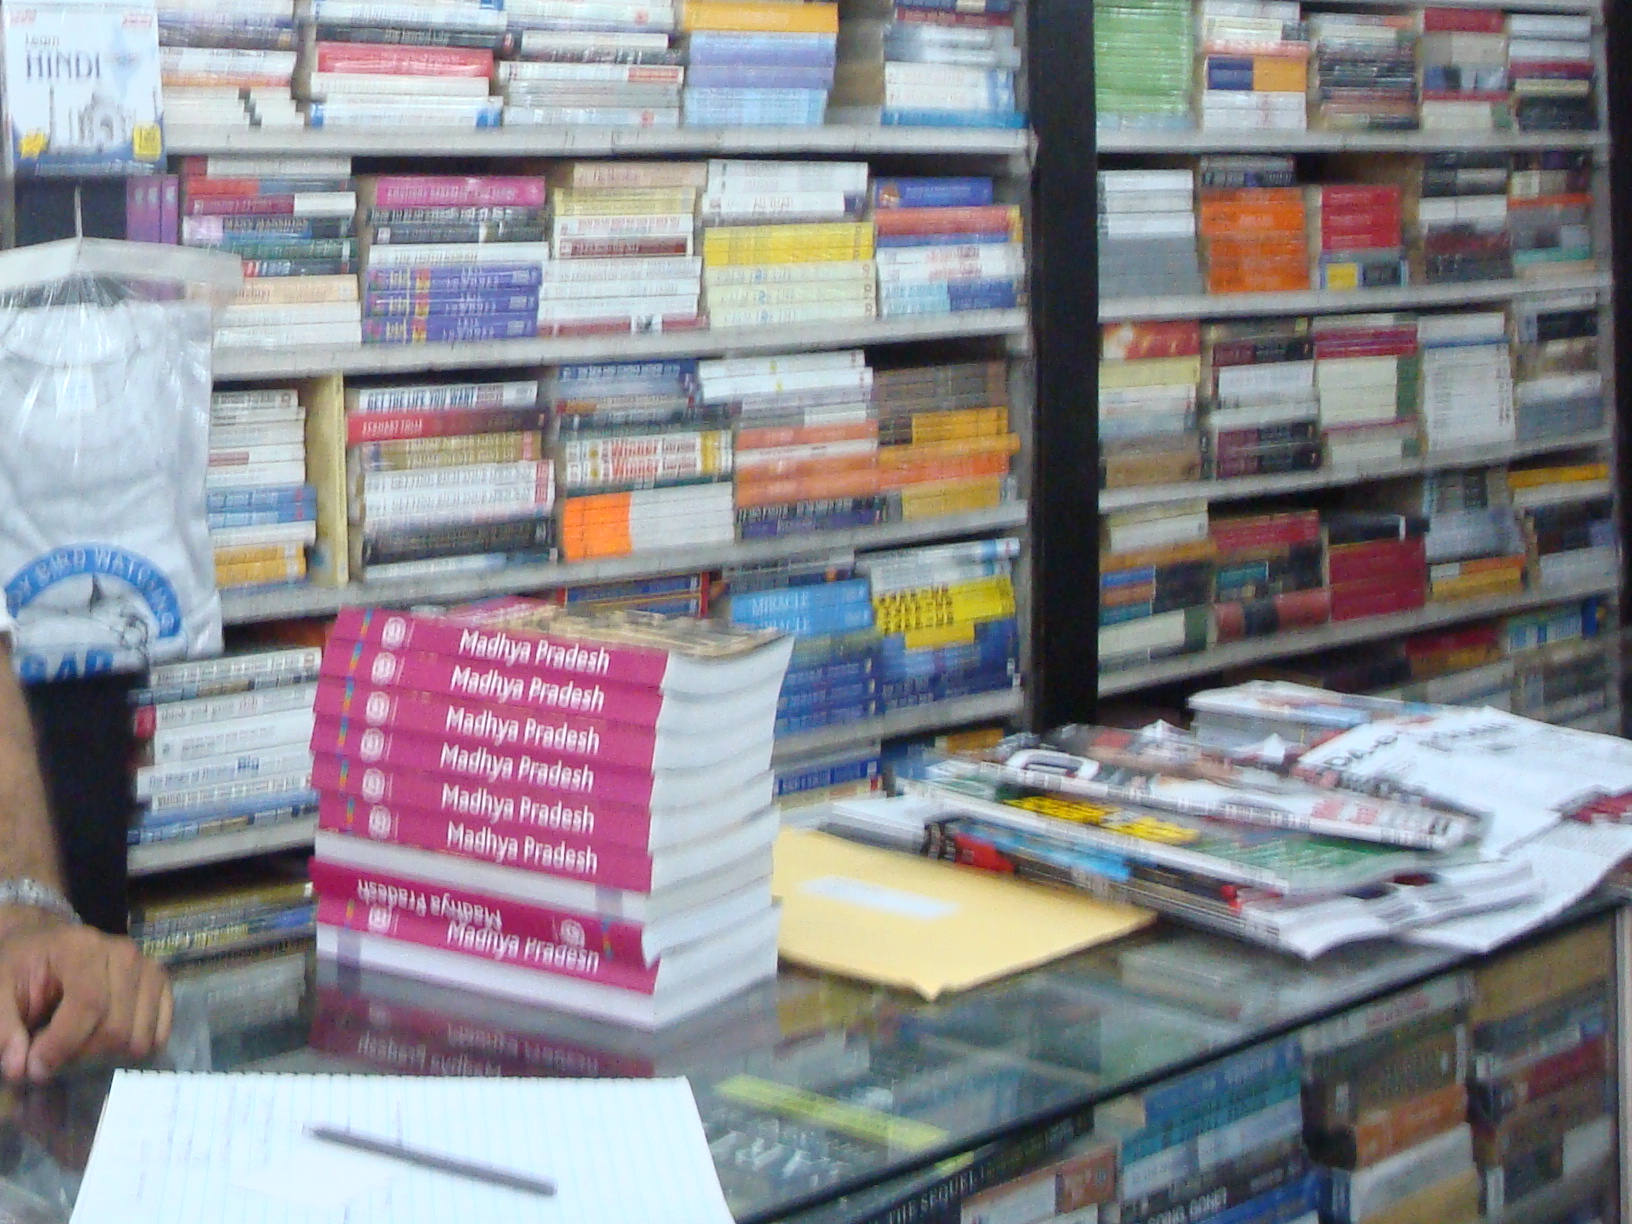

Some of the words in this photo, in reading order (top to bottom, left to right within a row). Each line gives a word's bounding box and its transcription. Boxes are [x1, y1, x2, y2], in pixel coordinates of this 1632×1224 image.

[26, 32, 60, 46] Learn
[26, 51, 101, 80] HINDI
[459, 628, 530, 667] Madhya
[535, 640, 610, 675] Pradesh
[450, 666, 524, 705] Madhya
[529, 677, 605, 713] Pradesh
[446, 705, 519, 745] Madhya
[524, 718, 600, 755] Pradesh
[440, 742, 514, 782] Madhya
[518, 755, 595, 793] Pradesh
[441, 783, 514, 824] Madhya
[520, 796, 595, 834] Pradesh
[447, 821, 519, 862] Madhya
[523, 835, 598, 875] Pradesh
[357, 880, 426, 917] Pradesh
[430, 893, 503, 929] Madhya
[447, 922, 520, 961] Madhya
[526, 937, 599, 973] Pradesh
